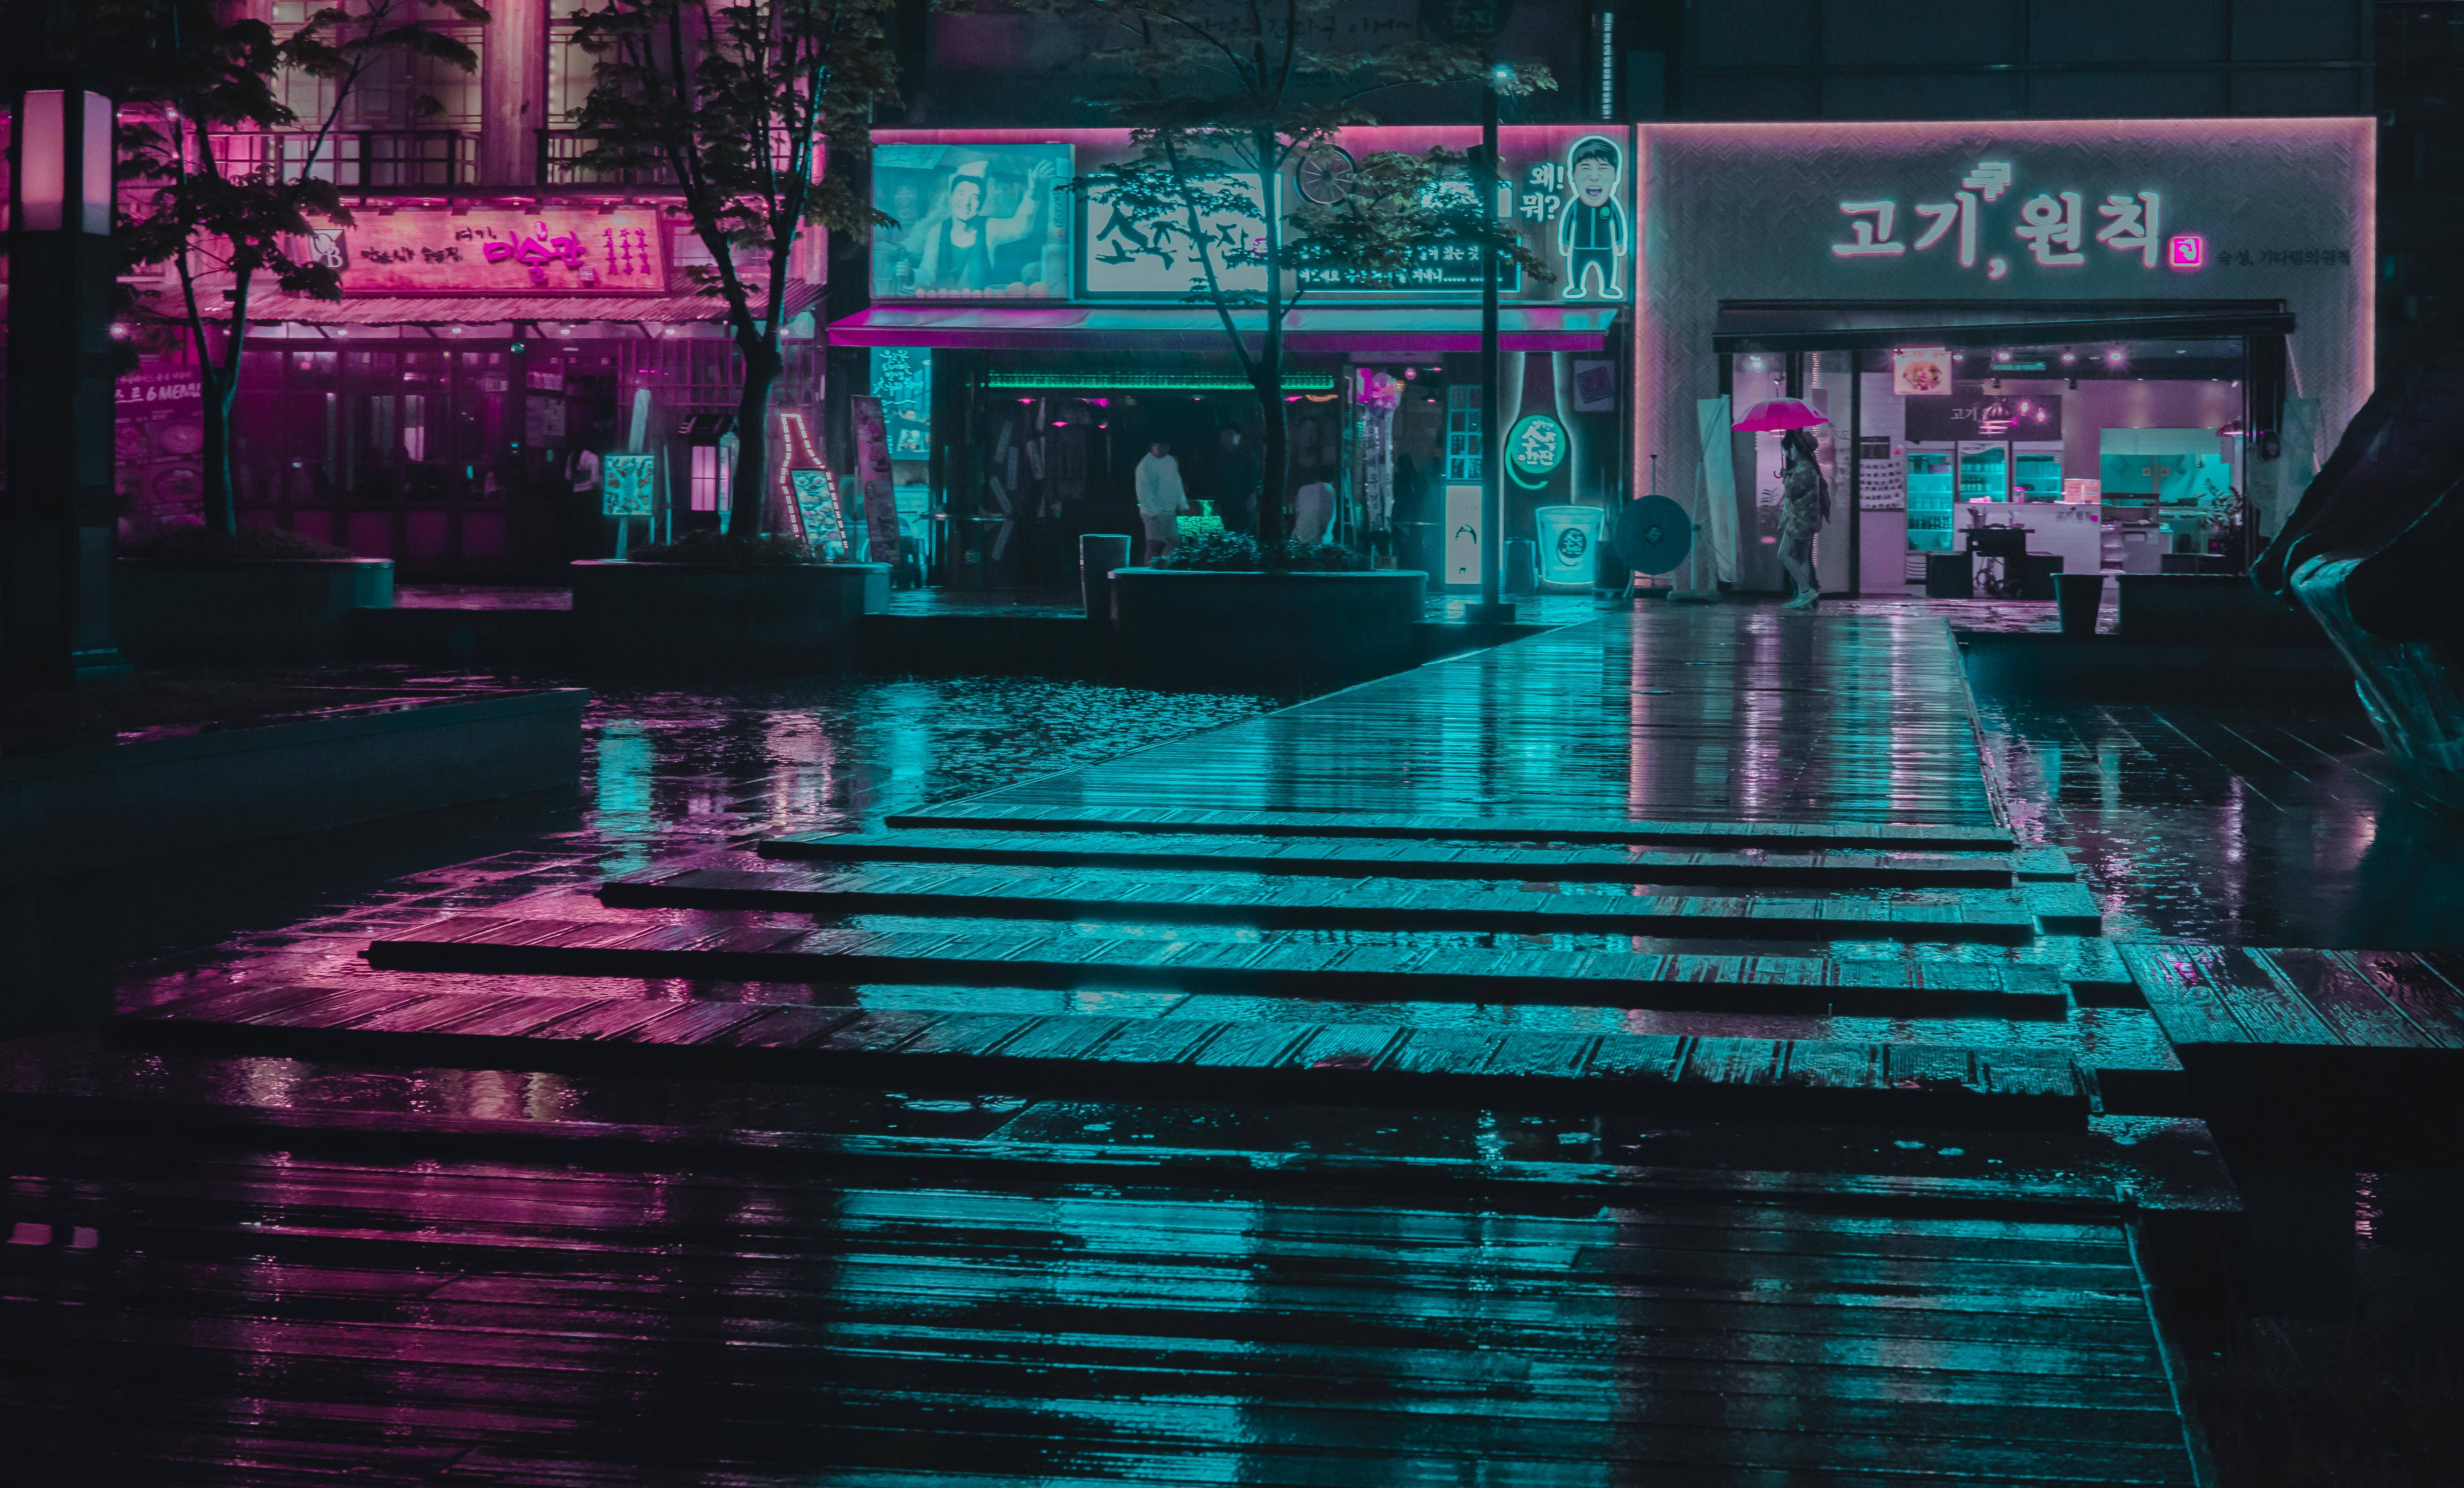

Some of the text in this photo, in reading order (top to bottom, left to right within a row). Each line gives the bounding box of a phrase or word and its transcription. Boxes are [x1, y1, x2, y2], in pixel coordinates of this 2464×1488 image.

[1529, 162, 1564, 193] 왜!
[1519, 193, 1561, 223] 뭐?
[2014, 191, 2160, 267] 원칙
[483, 230, 586, 283] 미술관
